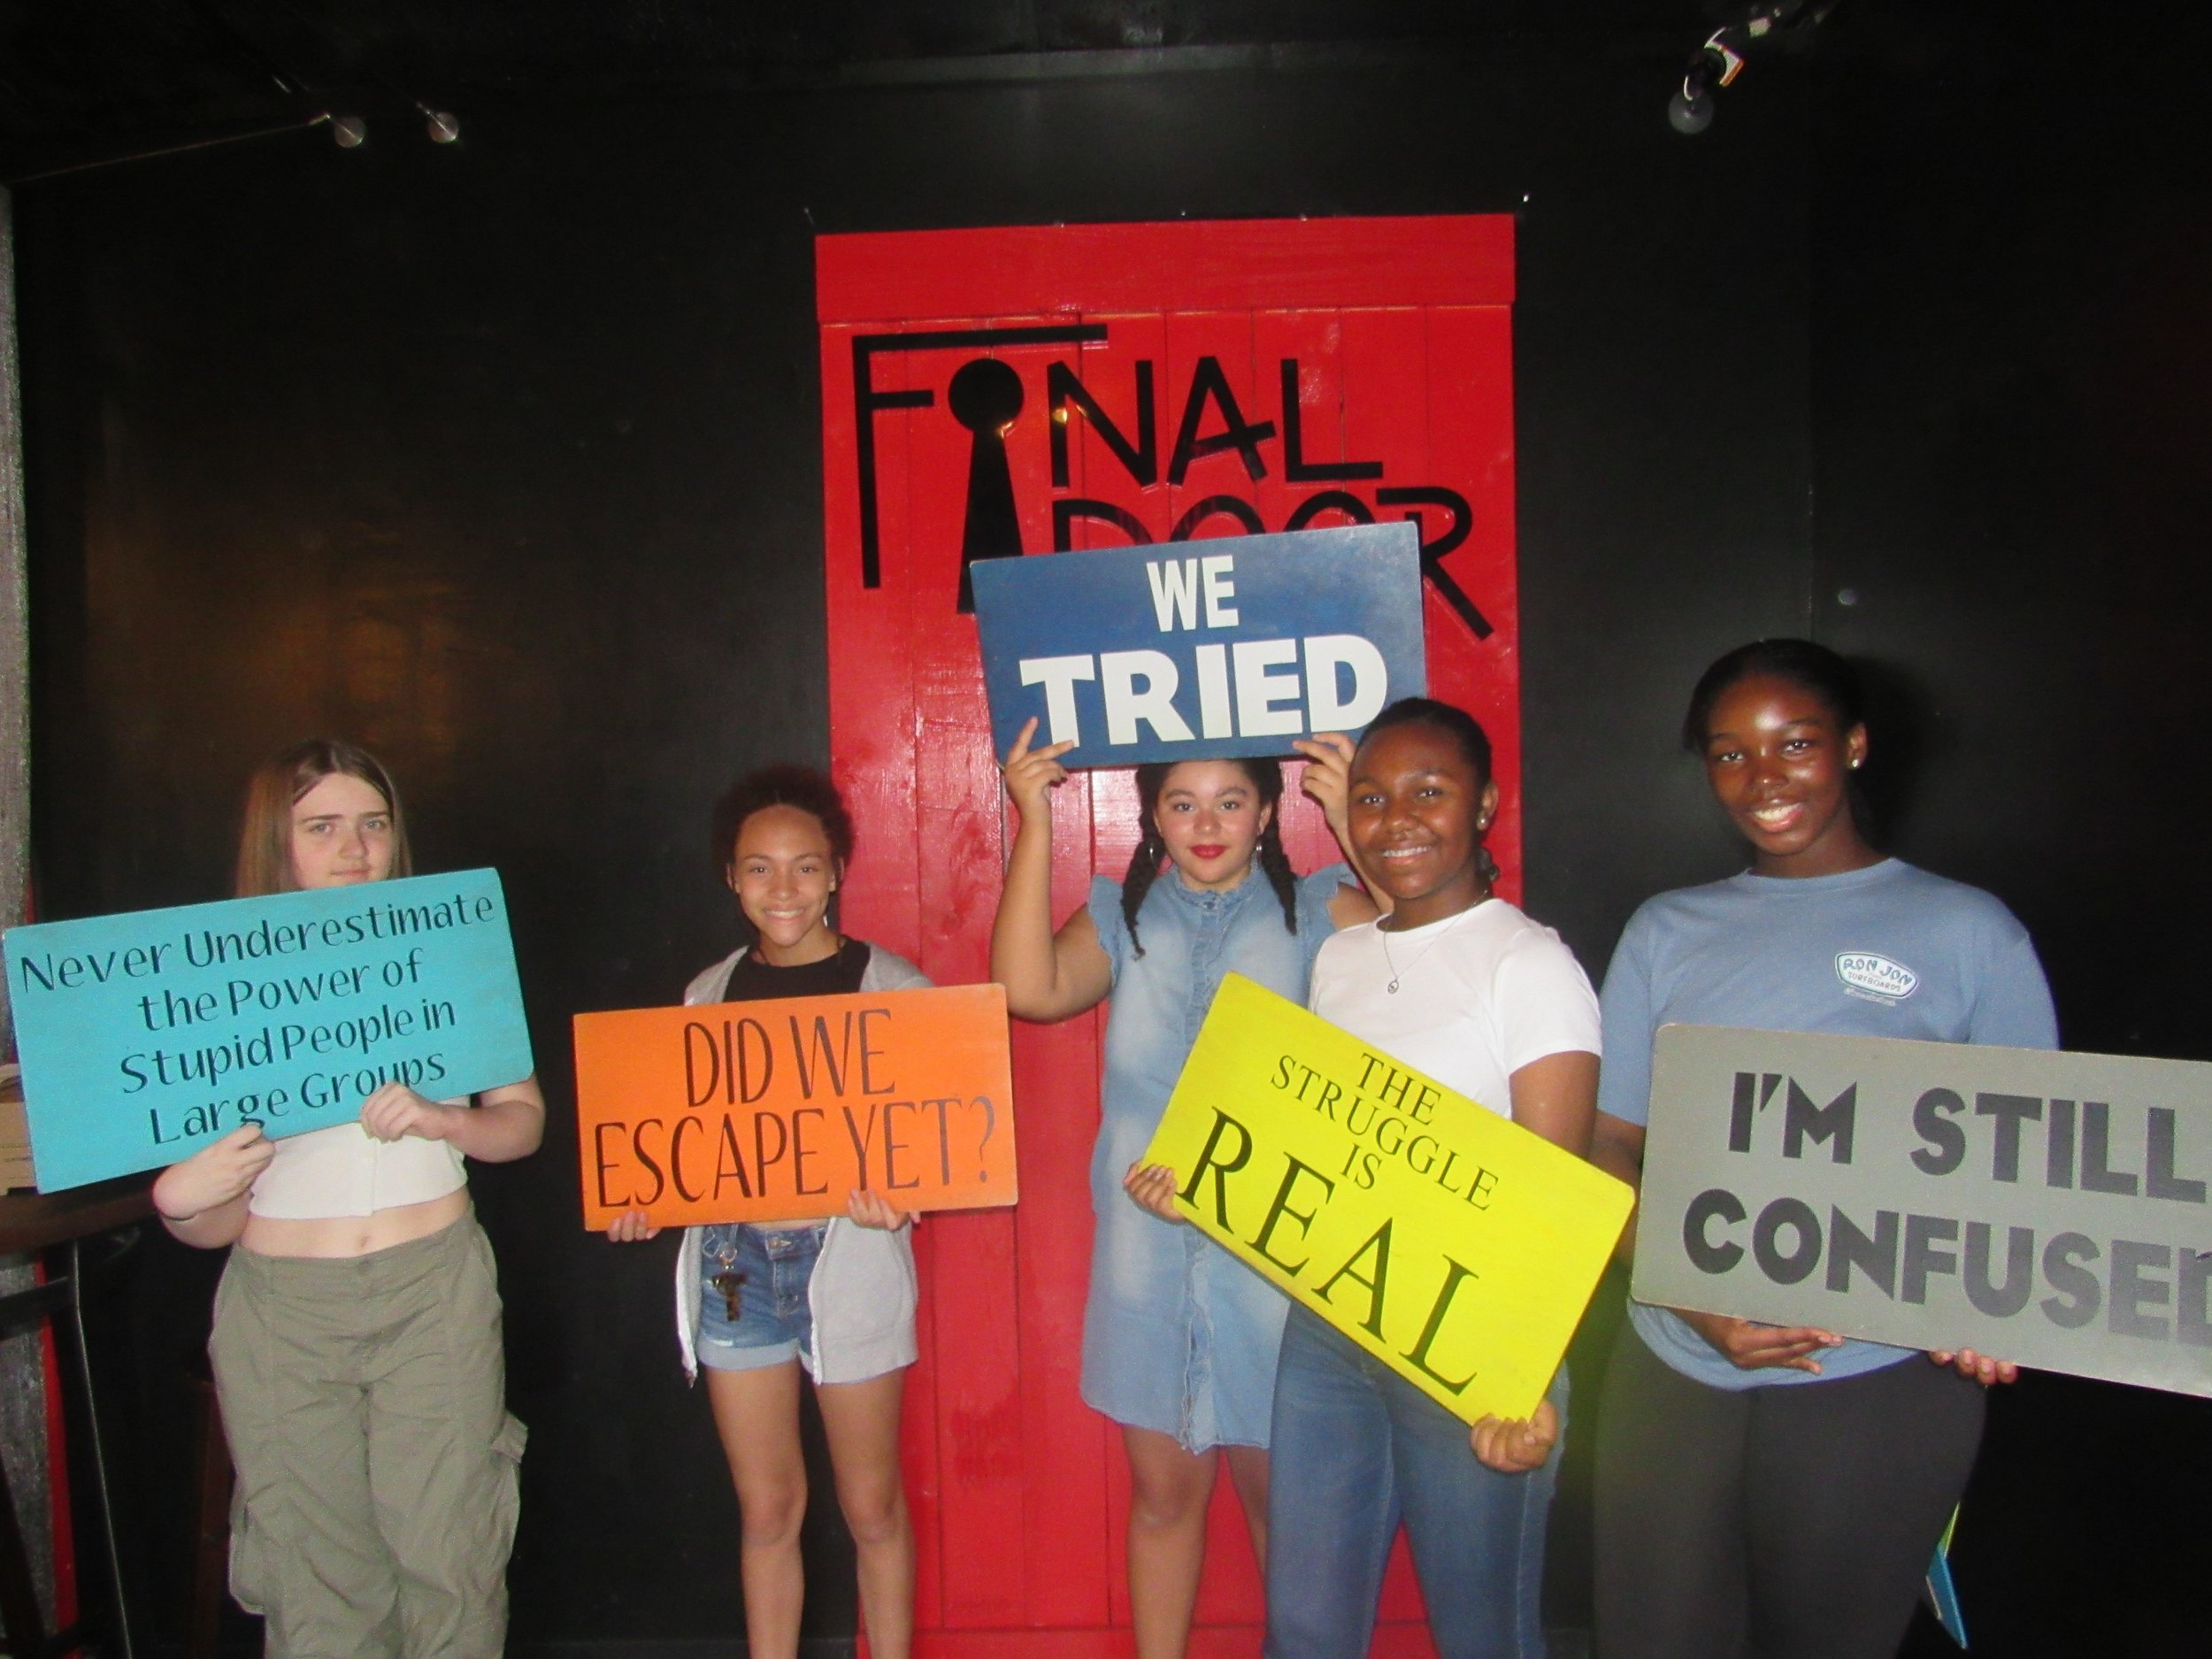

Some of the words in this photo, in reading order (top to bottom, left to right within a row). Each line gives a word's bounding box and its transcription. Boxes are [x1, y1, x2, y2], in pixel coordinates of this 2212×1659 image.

[1146, 555, 1240, 633] WE
[1019, 634, 1388, 749] TRIED
[20, 941, 172, 994] Never
[184, 895, 495, 968] Underestimate
[138, 989, 219, 1033] the
[228, 963, 371, 1016] Power
[382, 948, 424, 987] of
[1843, 957, 1878, 972] RON
[1880, 966, 1913, 986] JON
[120, 1027, 274, 1094] Stupid
[281, 1003, 414, 1061] People
[424, 999, 456, 1032] in
[683, 1018, 774, 1108] DID
[789, 1008, 896, 1101] WE
[1355, 1052, 1442, 1126] THE
[149, 1091, 291, 1146] Large
[301, 1053, 446, 1111] Groups
[1271, 1055, 1500, 1211] STRUGGLE
[1728, 1071, 1857, 1165] I'M
[1909, 1087, 2208, 1204] STILL
[595, 1108, 828, 1208] ESCAPE
[842, 1095, 996, 1191] YET?
[1340, 1142, 1383, 1190] IS
[1176, 1106, 1480, 1397] REAL
